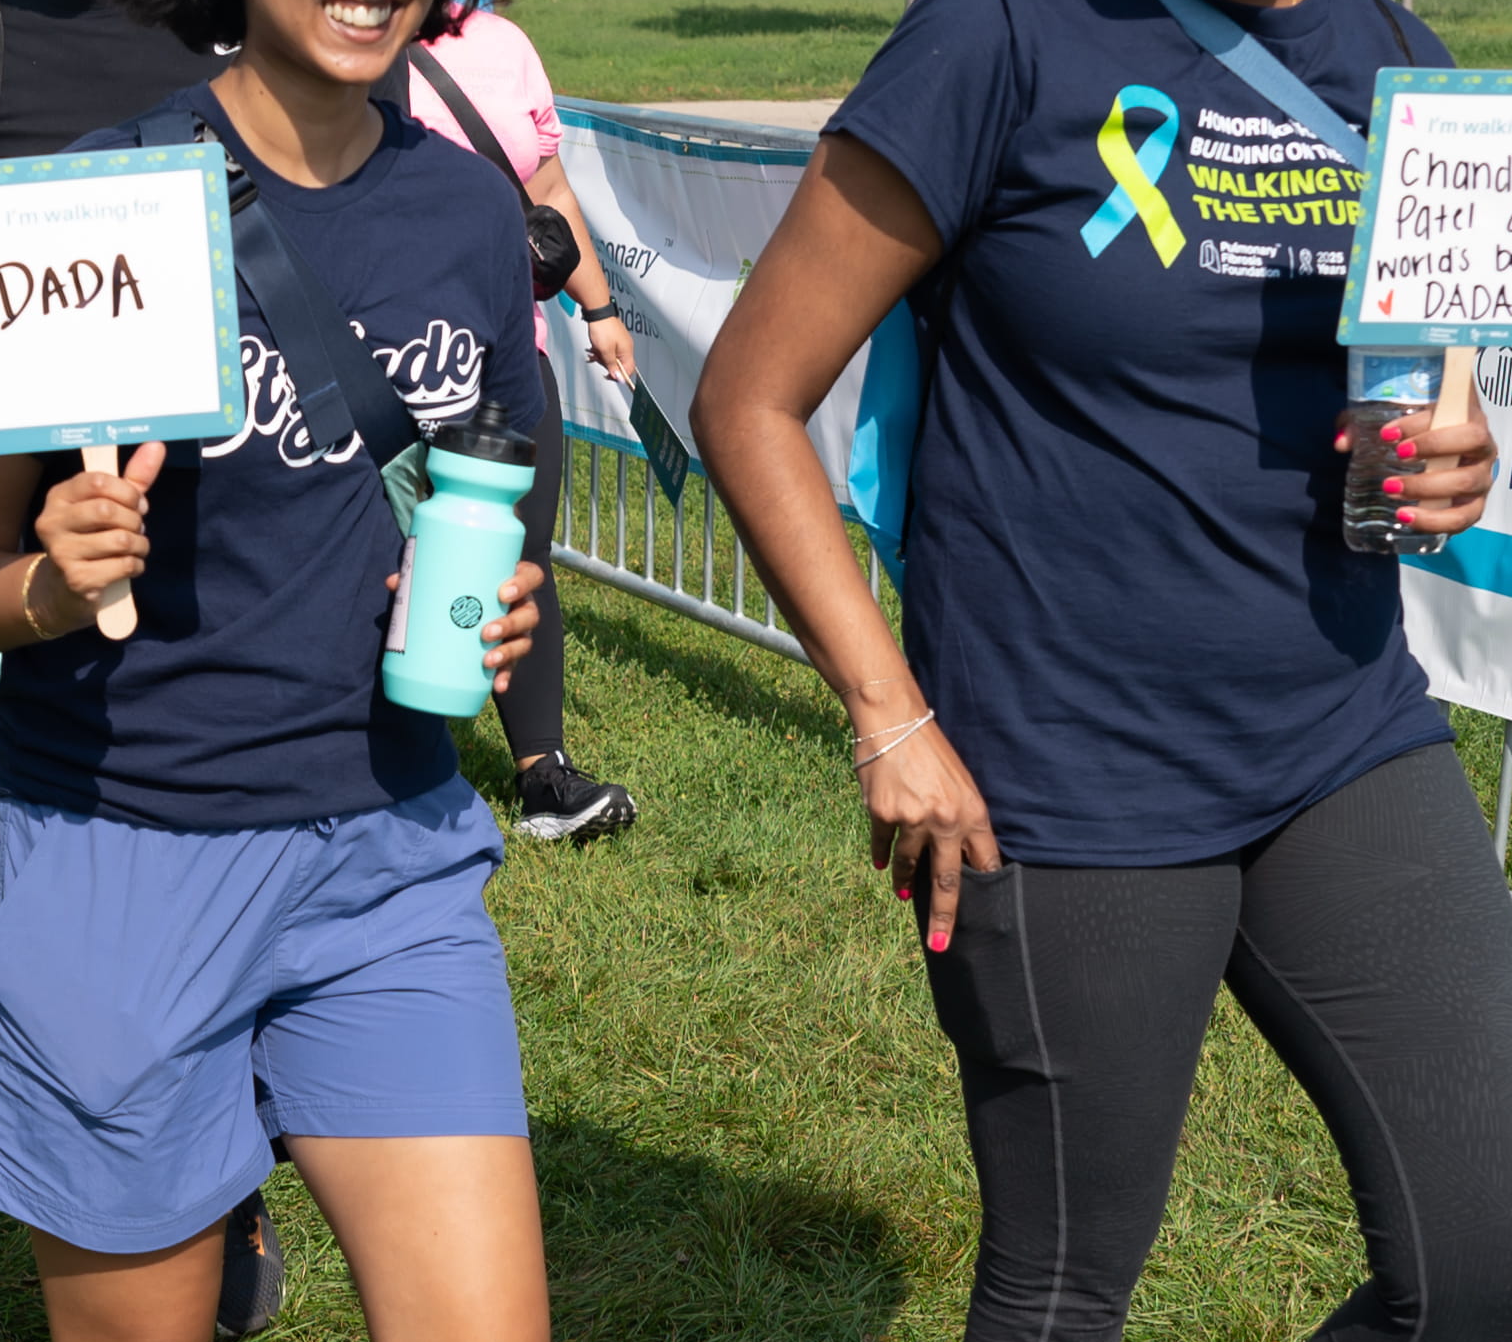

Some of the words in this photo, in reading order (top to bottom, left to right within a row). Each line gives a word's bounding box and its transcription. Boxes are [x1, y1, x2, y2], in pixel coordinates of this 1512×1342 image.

[1428, 117, 1457, 133] I'm
[1190, 136, 1284, 165] BUILDING
[1187, 163, 1341, 198] WALKING
[43, 203, 128, 223] walking
[133, 199, 161, 216] for
[1192, 195, 1261, 224] THE
[1260, 199, 1362, 226] FUTUR
[1397, 195, 1474, 240] Patel
[1377, 246, 1470, 282] world's
